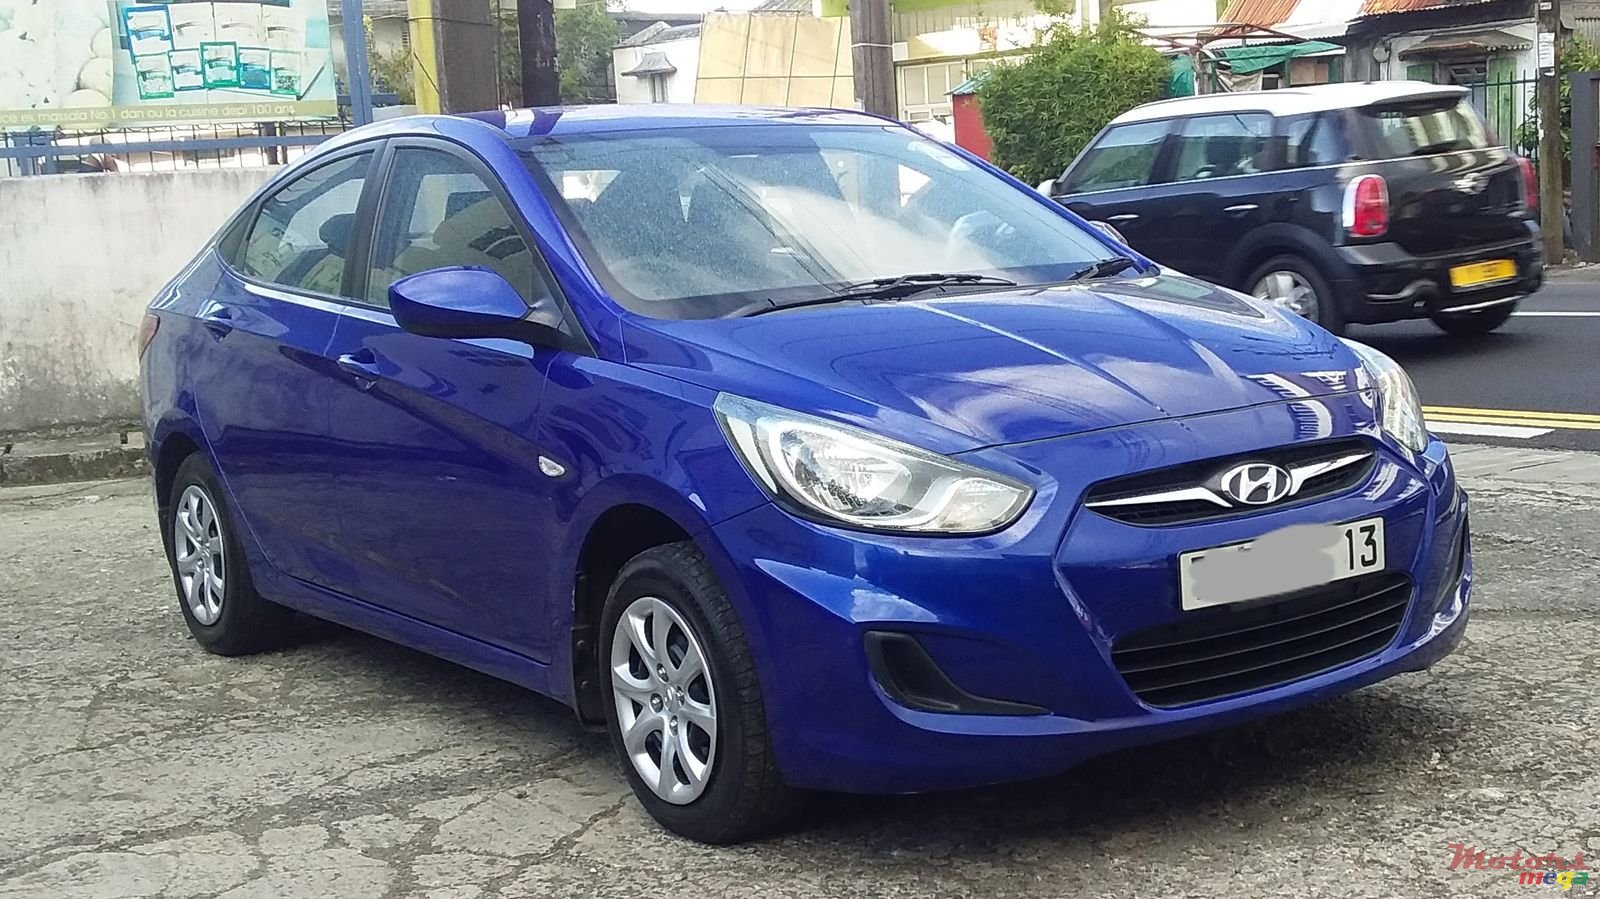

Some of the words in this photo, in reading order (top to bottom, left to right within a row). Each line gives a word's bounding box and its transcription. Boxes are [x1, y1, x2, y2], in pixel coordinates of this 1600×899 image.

[38, 111, 87, 121] massala
[121, 109, 144, 119] dan
[147, 110, 162, 118] ou
[165, 108, 176, 117] la
[179, 107, 218, 117] cuisine
[221, 105, 247, 117] depi
[250, 104, 271, 115] 100
[1345, 524, 1377, 570] 13
